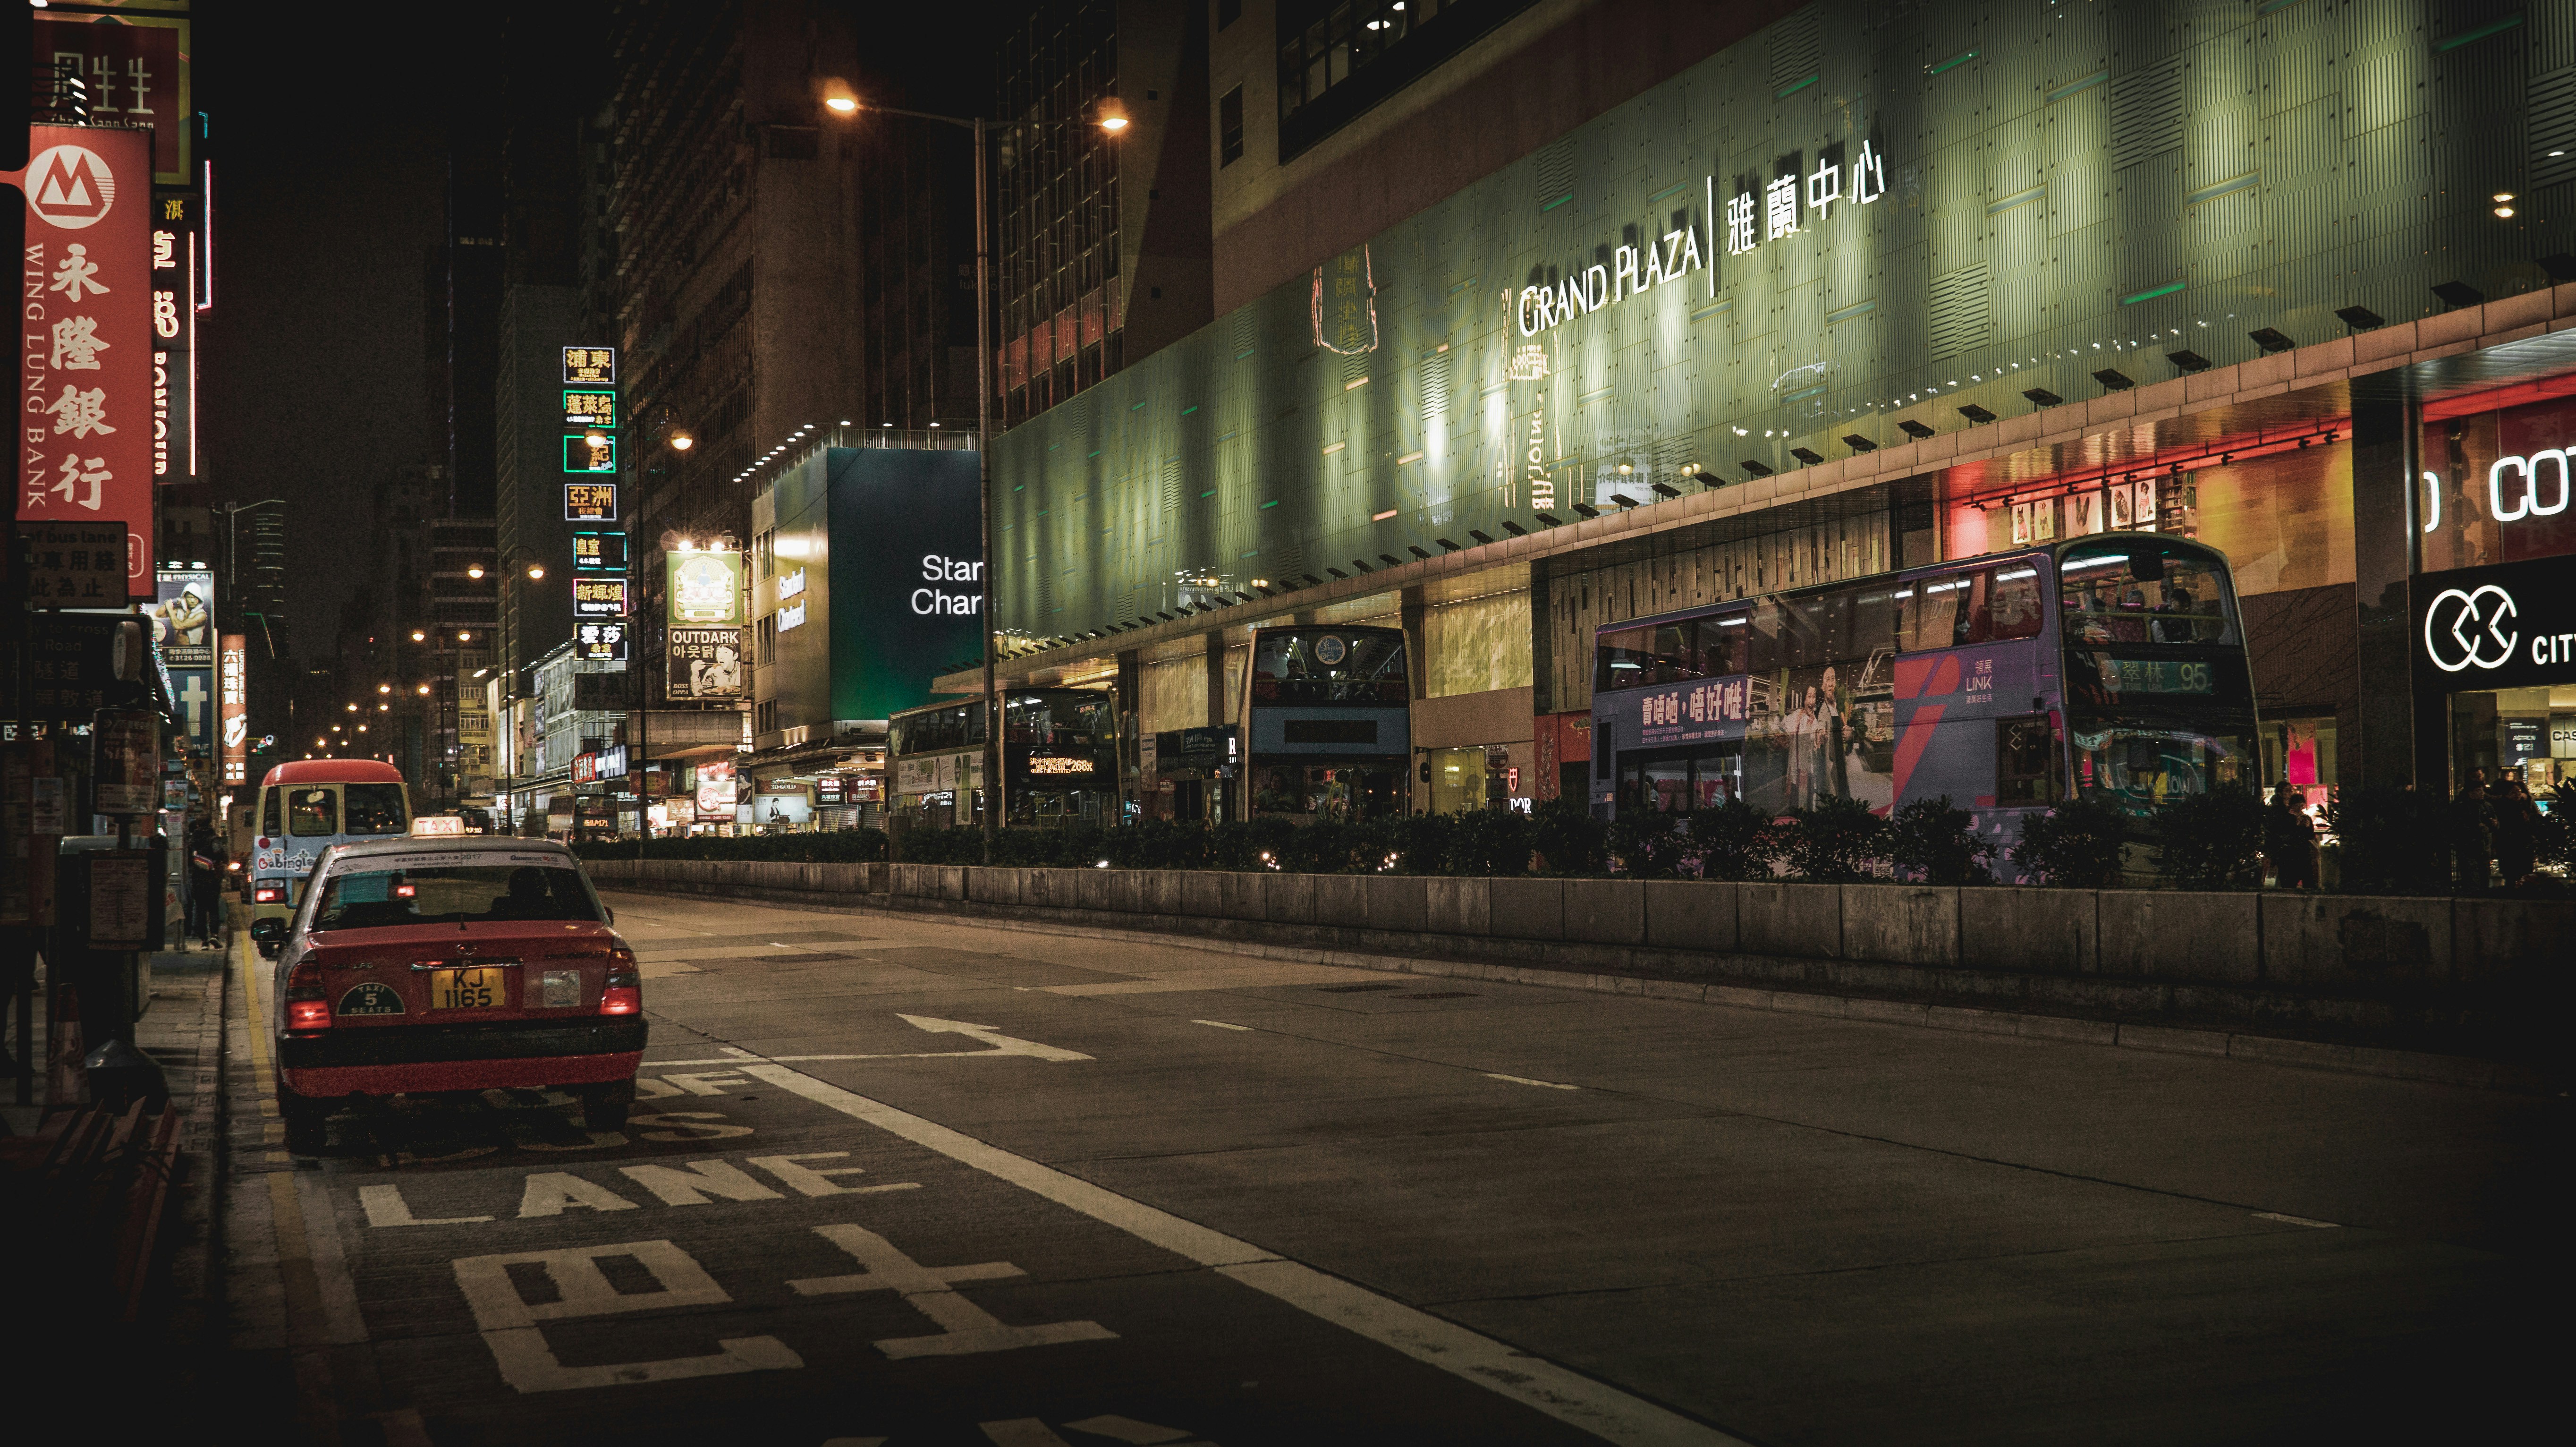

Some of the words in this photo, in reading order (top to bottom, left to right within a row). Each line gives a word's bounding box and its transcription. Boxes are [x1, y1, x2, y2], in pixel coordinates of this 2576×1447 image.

[1728, 139, 1885, 254] 雅蘭中心
[25, 243, 44, 321] WING
[1519, 263, 1607, 337] GRAND
[1615, 225, 1701, 303] PLAZA
[567, 349, 611, 367] 浦東
[26, 336, 46, 414] LUNG
[46, 244, 117, 511] 永隆銀行
[27, 428, 46, 509] BANK
[2490, 446, 2576, 522] CO
[568, 486, 612, 507] 亞洲
[47, 531, 77, 543] bus
[81, 531, 117, 543] lane
[576, 538, 600, 555] 皇室
[45, 638, 82, 651] Road
[672, 631, 739, 644] OUTDARK
[673, 645, 714, 658] 아웃닭
[2532, 634, 2576, 665] CIT
[1966, 676, 1992, 691] LINK
[2122, 662, 2164, 683] 翠林
[2180, 664, 2207, 691] 95
[419, 820, 459, 832] TAXI
[453, 969, 484, 988] KJ
[358, 985, 384, 993] TAXI
[445, 988, 491, 1008] 1165
[364, 993, 377, 1006] 5
[351, 1006, 391, 1014] SEATS
[357, 1150, 923, 1228] LANE
[451, 1222, 1122, 1394] 巴士
